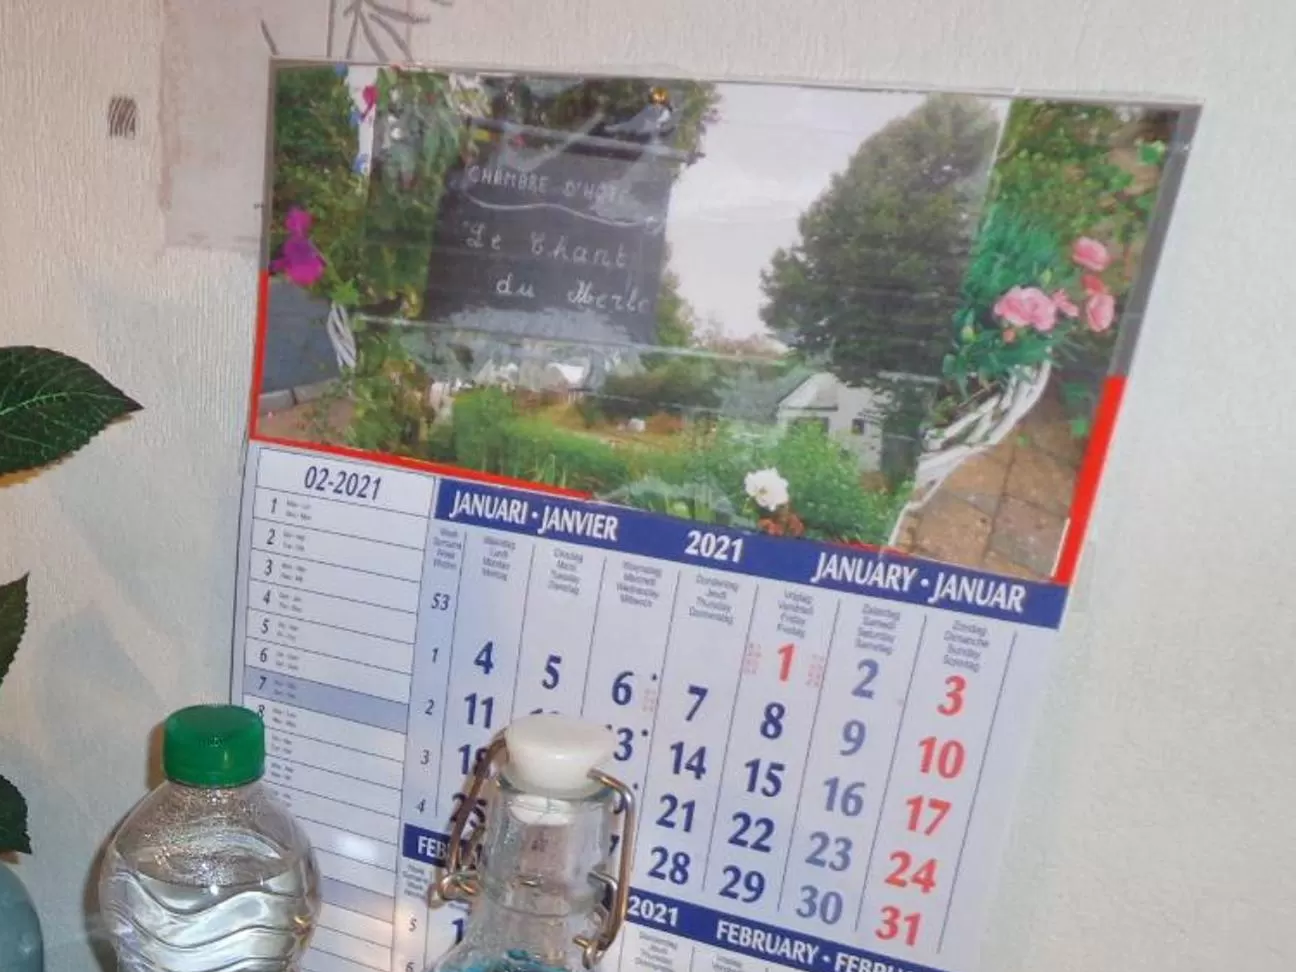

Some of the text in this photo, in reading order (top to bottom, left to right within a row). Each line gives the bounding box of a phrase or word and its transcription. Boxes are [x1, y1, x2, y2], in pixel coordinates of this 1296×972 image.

[304, 465, 381, 501] 02-2021
[449, 490, 1027, 613] JANUARI JANVIER 2021 JANUARY JANUAR
[431, 593, 450, 611] 53
[777, 643, 796, 682] 1
[852, 659, 880, 699] 2
[937, 674, 967, 716] 3
[474, 641, 494, 675] 4
[542, 655, 562, 690] 5
[612, 671, 636, 705] 6
[685, 685, 708, 721] 7
[760, 702, 786, 740] 8
[840, 719, 866, 756] 9
[918, 736, 965, 779] 10
[420, 749, 430, 765] 3
[656, 793, 696, 833] 21
[727, 812, 776, 853] 22
[805, 831, 853, 872] 23
[884, 850, 938, 895] 24
[425, 692, 951, 837] 2 11 3 14 15 16 17
[627, 895, 679, 927] 2021
[716, 920, 820, 965] FEBRUARY
[647, 846, 691, 885] 28
[718, 864, 765, 904] 29
[795, 885, 844, 925] 30
[874, 905, 925, 947] 31
